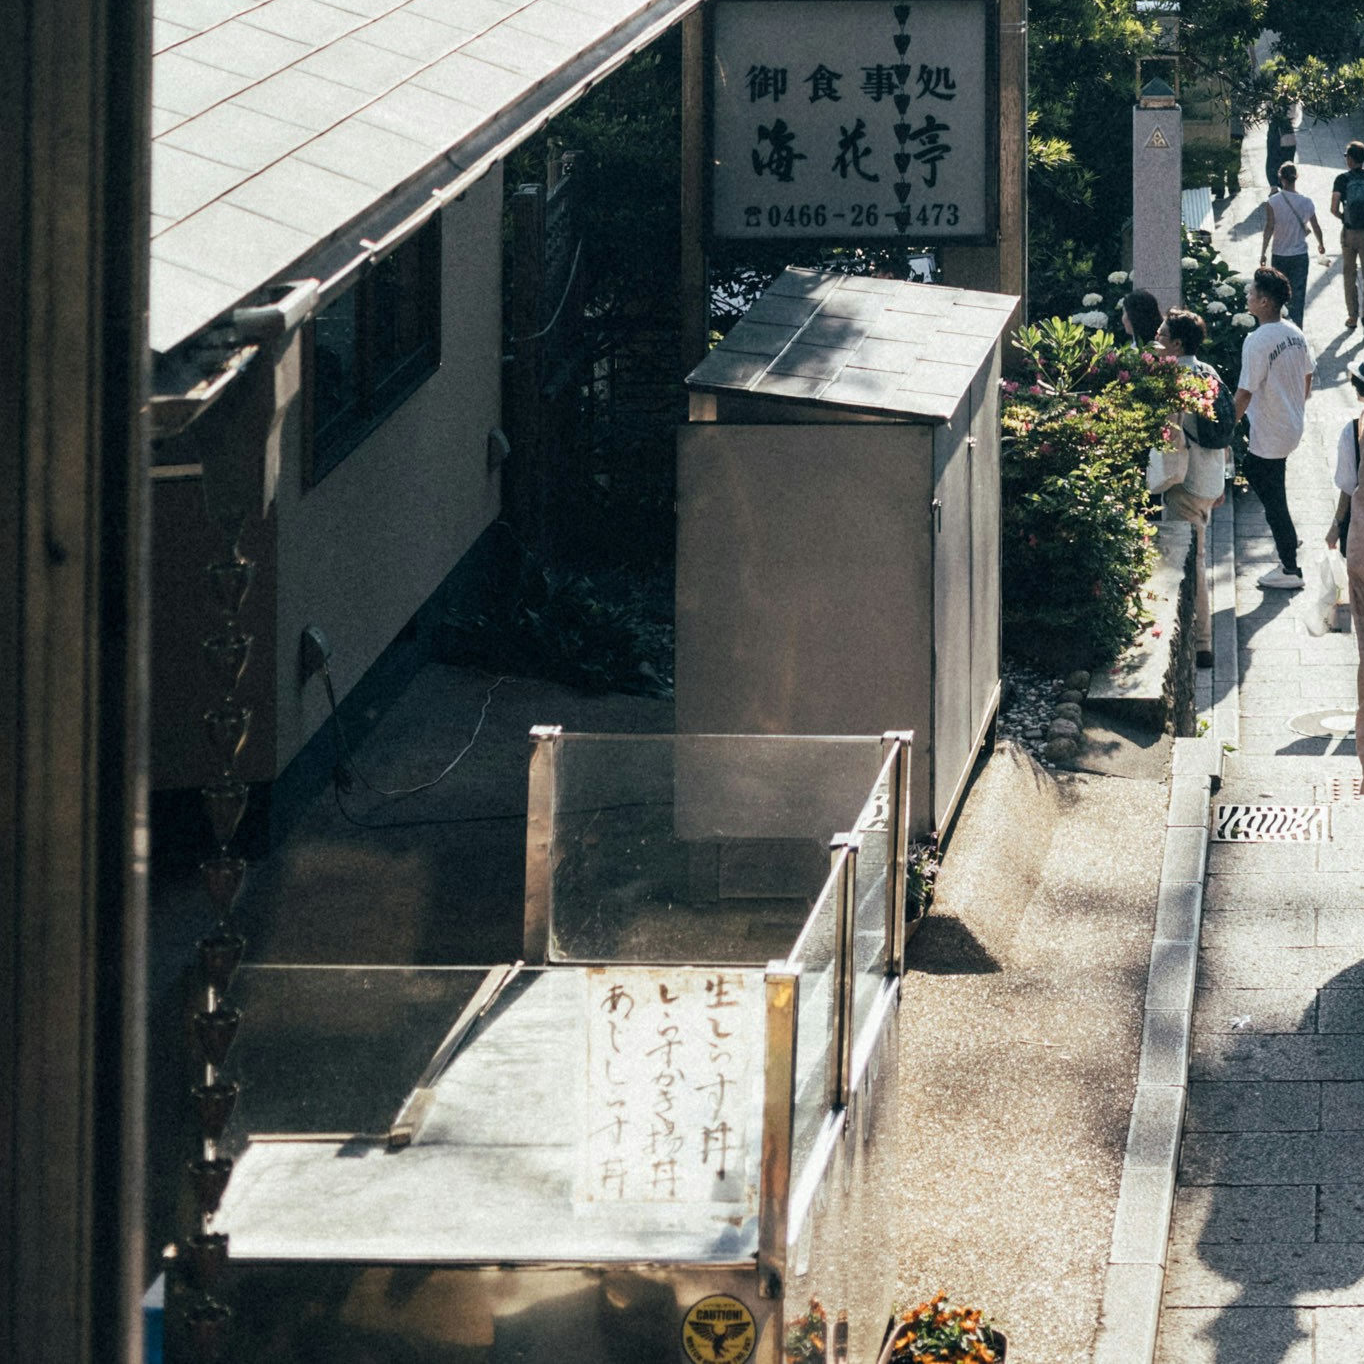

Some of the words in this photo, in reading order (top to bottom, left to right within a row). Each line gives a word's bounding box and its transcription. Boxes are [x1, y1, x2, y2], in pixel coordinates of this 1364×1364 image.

[744, 64, 957, 103] 御食事処
[752, 114, 952, 188] 海花亭
[696, 1309, 743, 1322] CAUTION!
